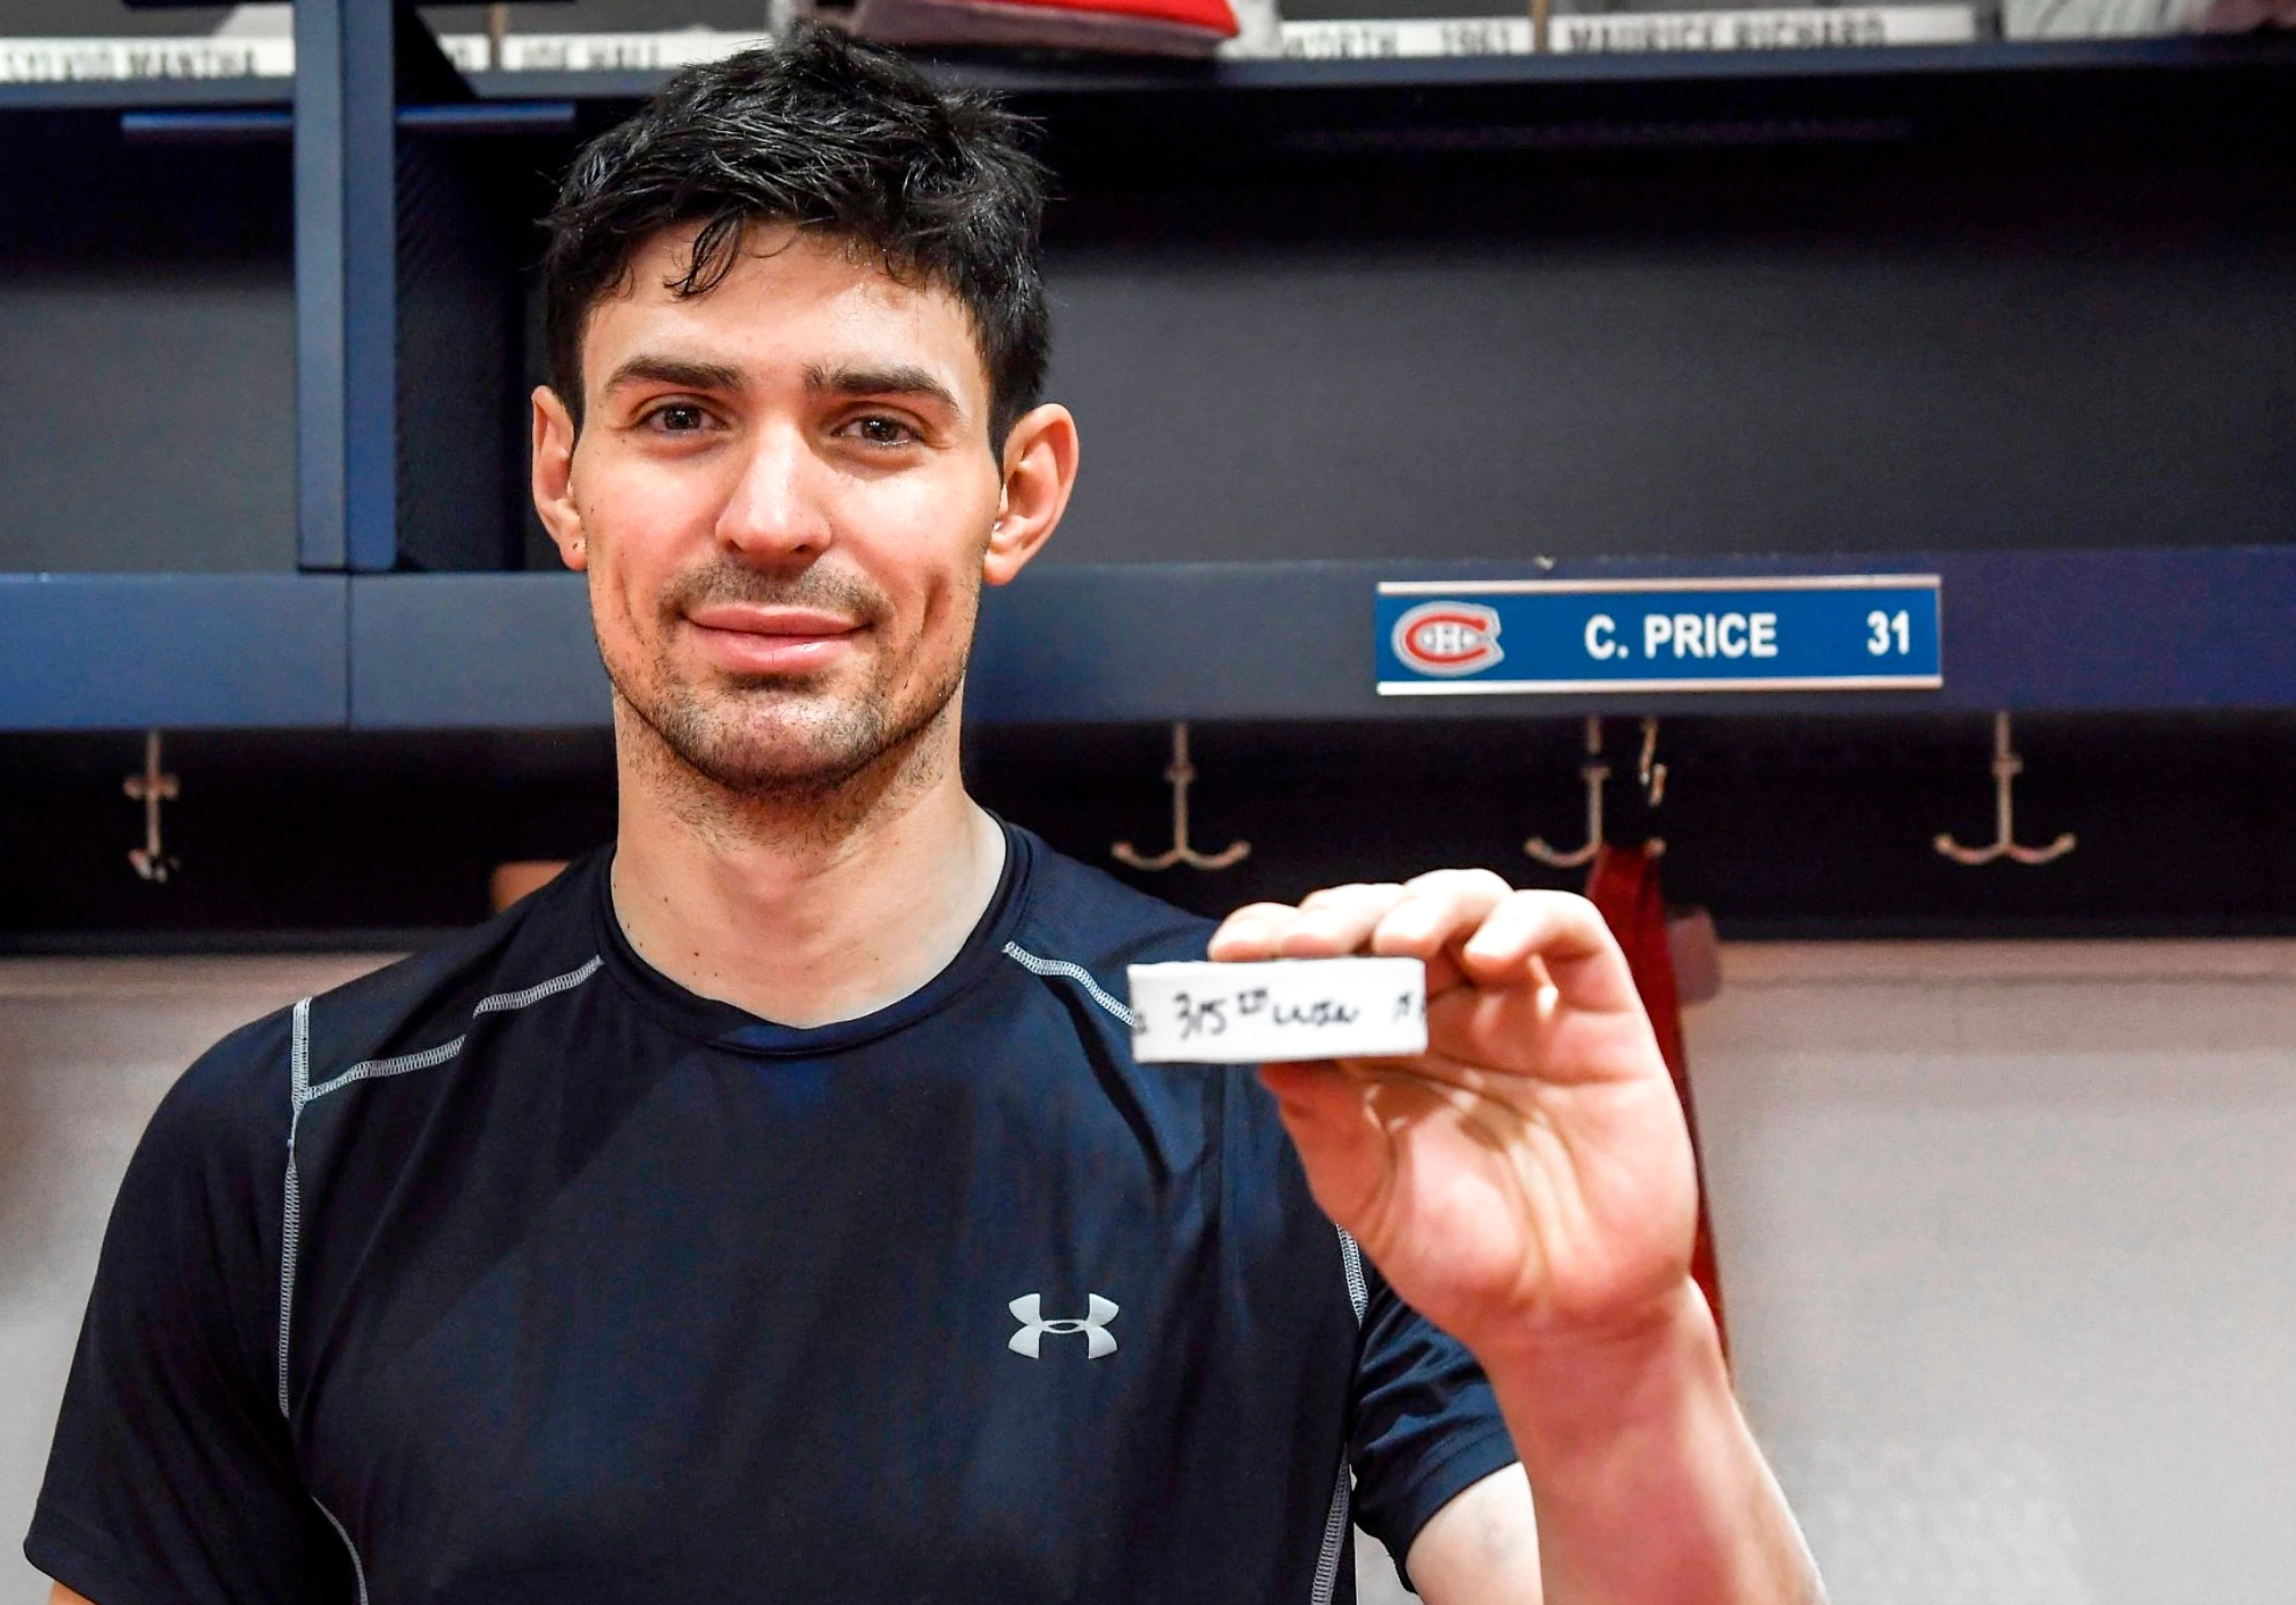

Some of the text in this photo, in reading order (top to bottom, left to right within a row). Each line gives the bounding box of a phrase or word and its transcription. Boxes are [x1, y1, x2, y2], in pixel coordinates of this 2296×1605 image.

[1585, 610, 1910, 660] C. PRICE 31
